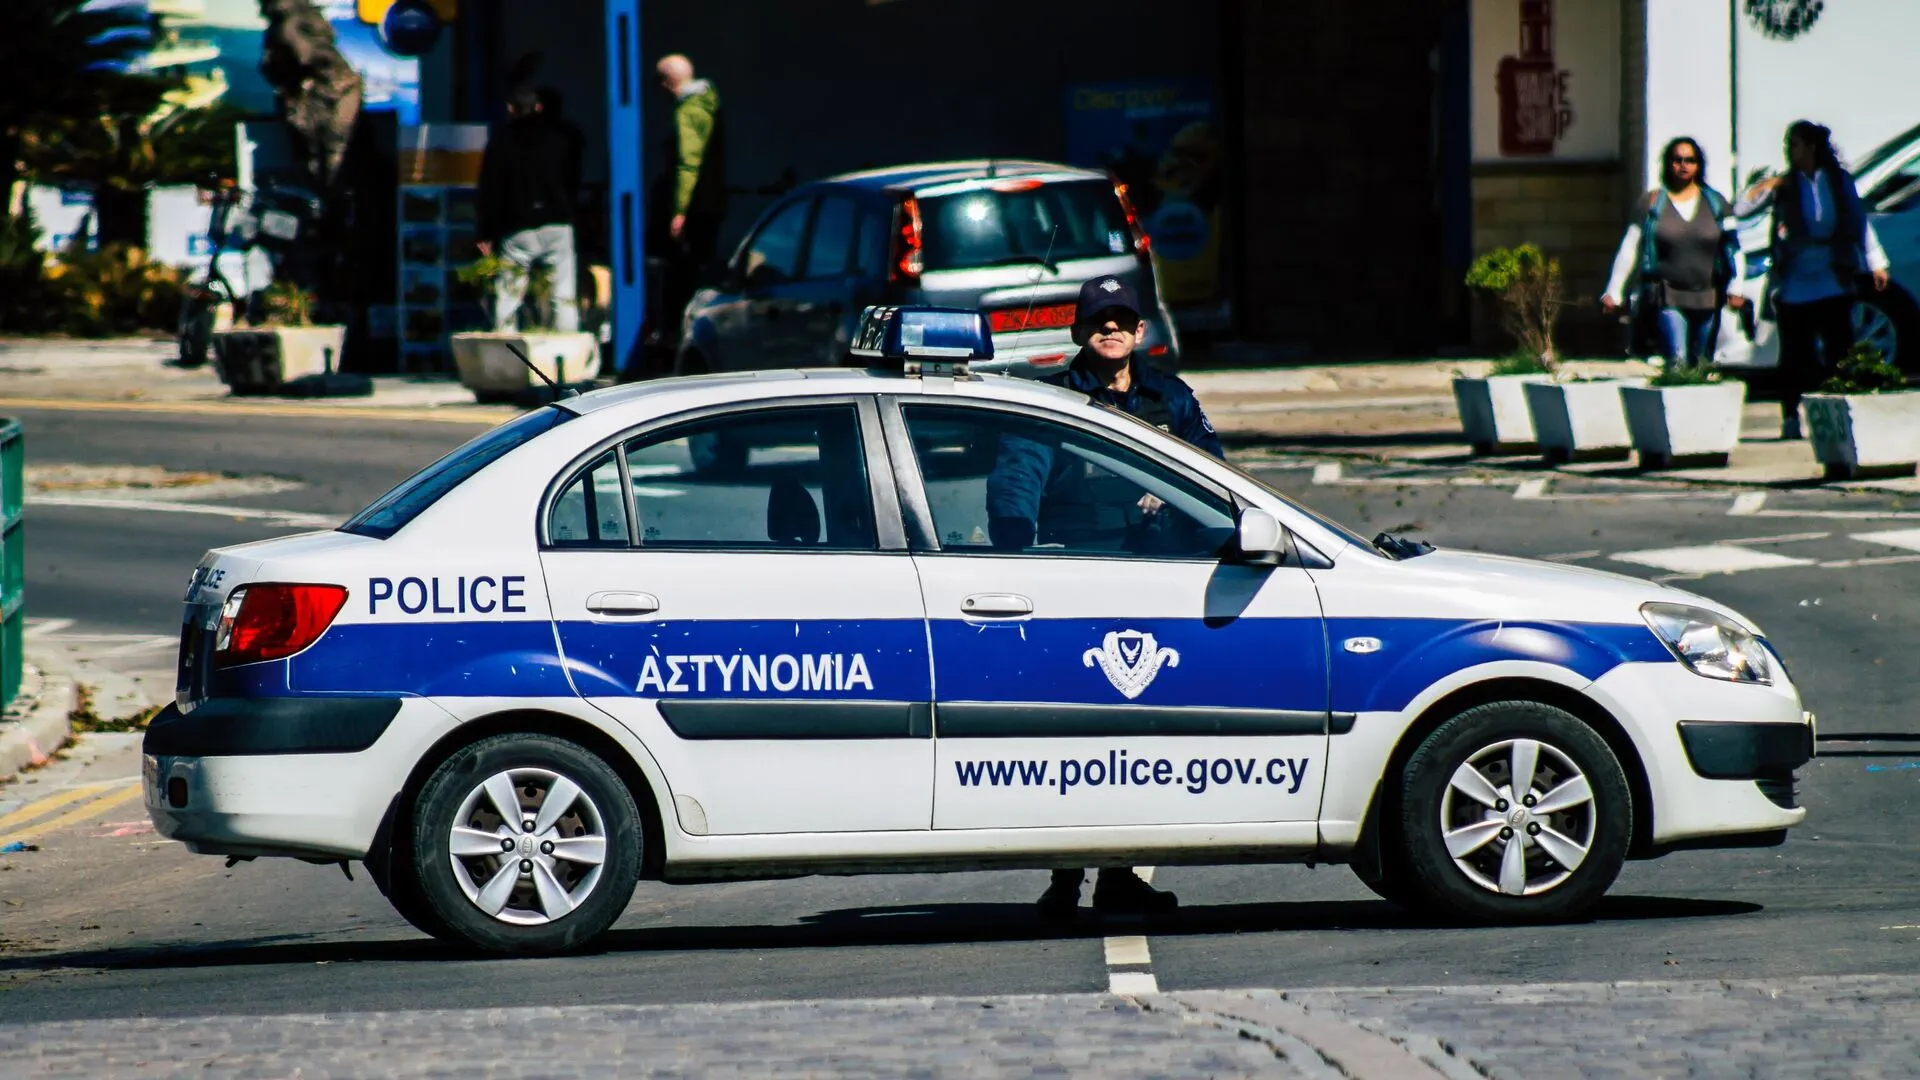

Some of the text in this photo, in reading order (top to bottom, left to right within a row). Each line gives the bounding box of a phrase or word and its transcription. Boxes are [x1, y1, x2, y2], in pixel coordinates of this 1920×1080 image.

[1516, 107, 1575, 142] SHOP
[369, 576, 526, 614] POLICE
[636, 653, 874, 692] ΑΣΤΥΝΟΜΙΑ
[955, 749, 1309, 795] www.police.gov.cy
